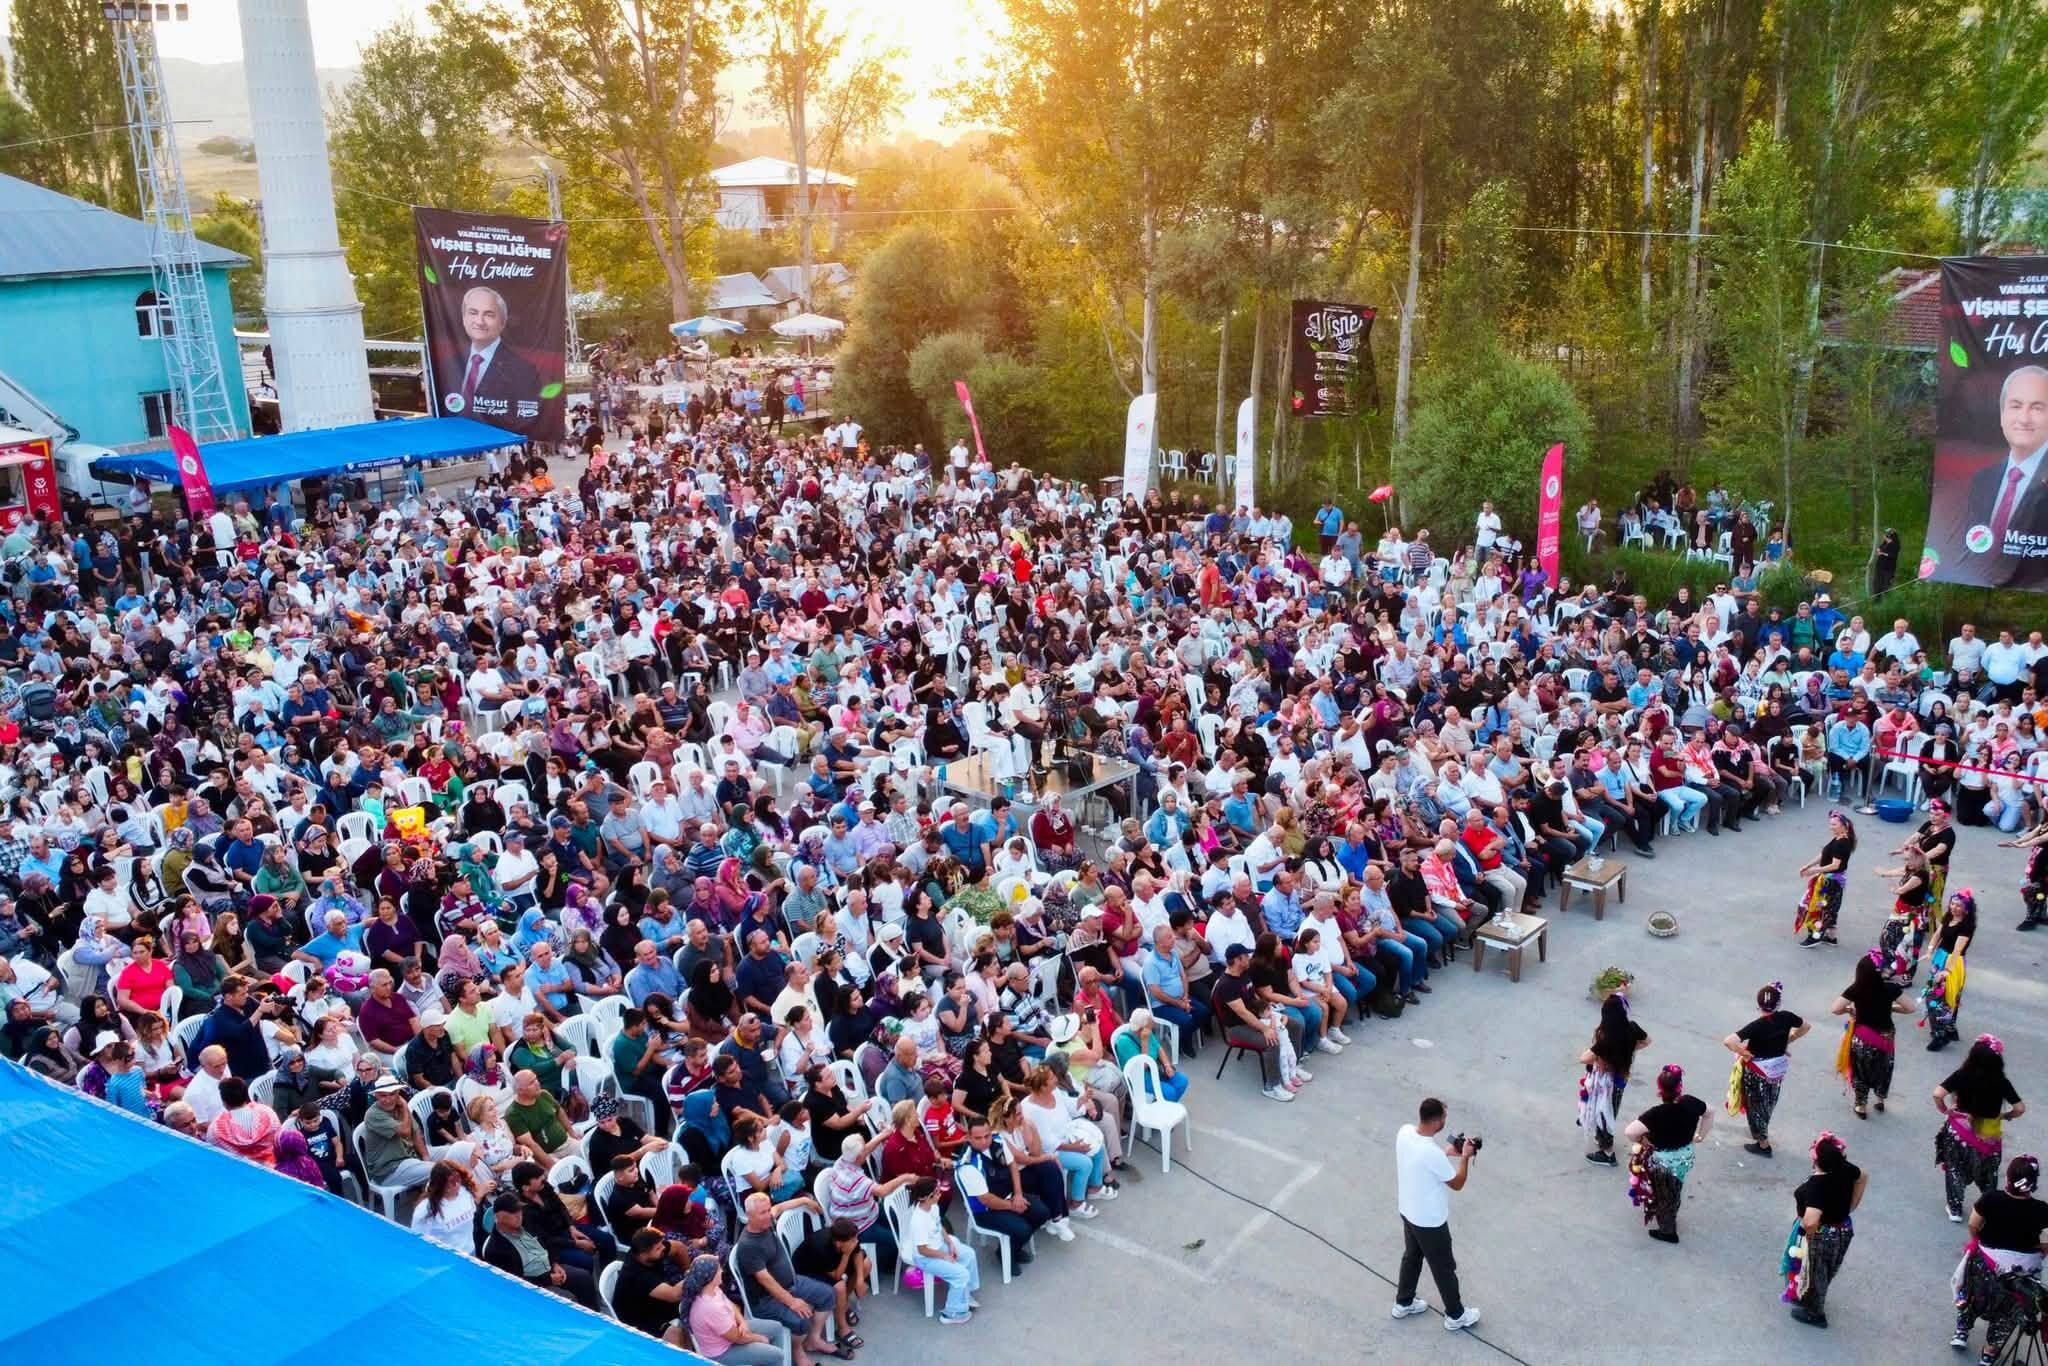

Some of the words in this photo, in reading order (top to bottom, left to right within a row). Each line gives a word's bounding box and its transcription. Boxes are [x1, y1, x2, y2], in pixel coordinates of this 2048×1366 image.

[457, 230, 490, 239] VARSAK
[431, 236, 473, 252] VİŞNE
[448, 256, 478, 280] Hoş
[481, 256, 534, 279] Geldiniz
[1999, 284, 2046, 295] VARSAK
[1961, 297, 2020, 319] VİŞNE
[1984, 321, 2026, 359] Hoş
[473, 395, 508, 408] Mesut
